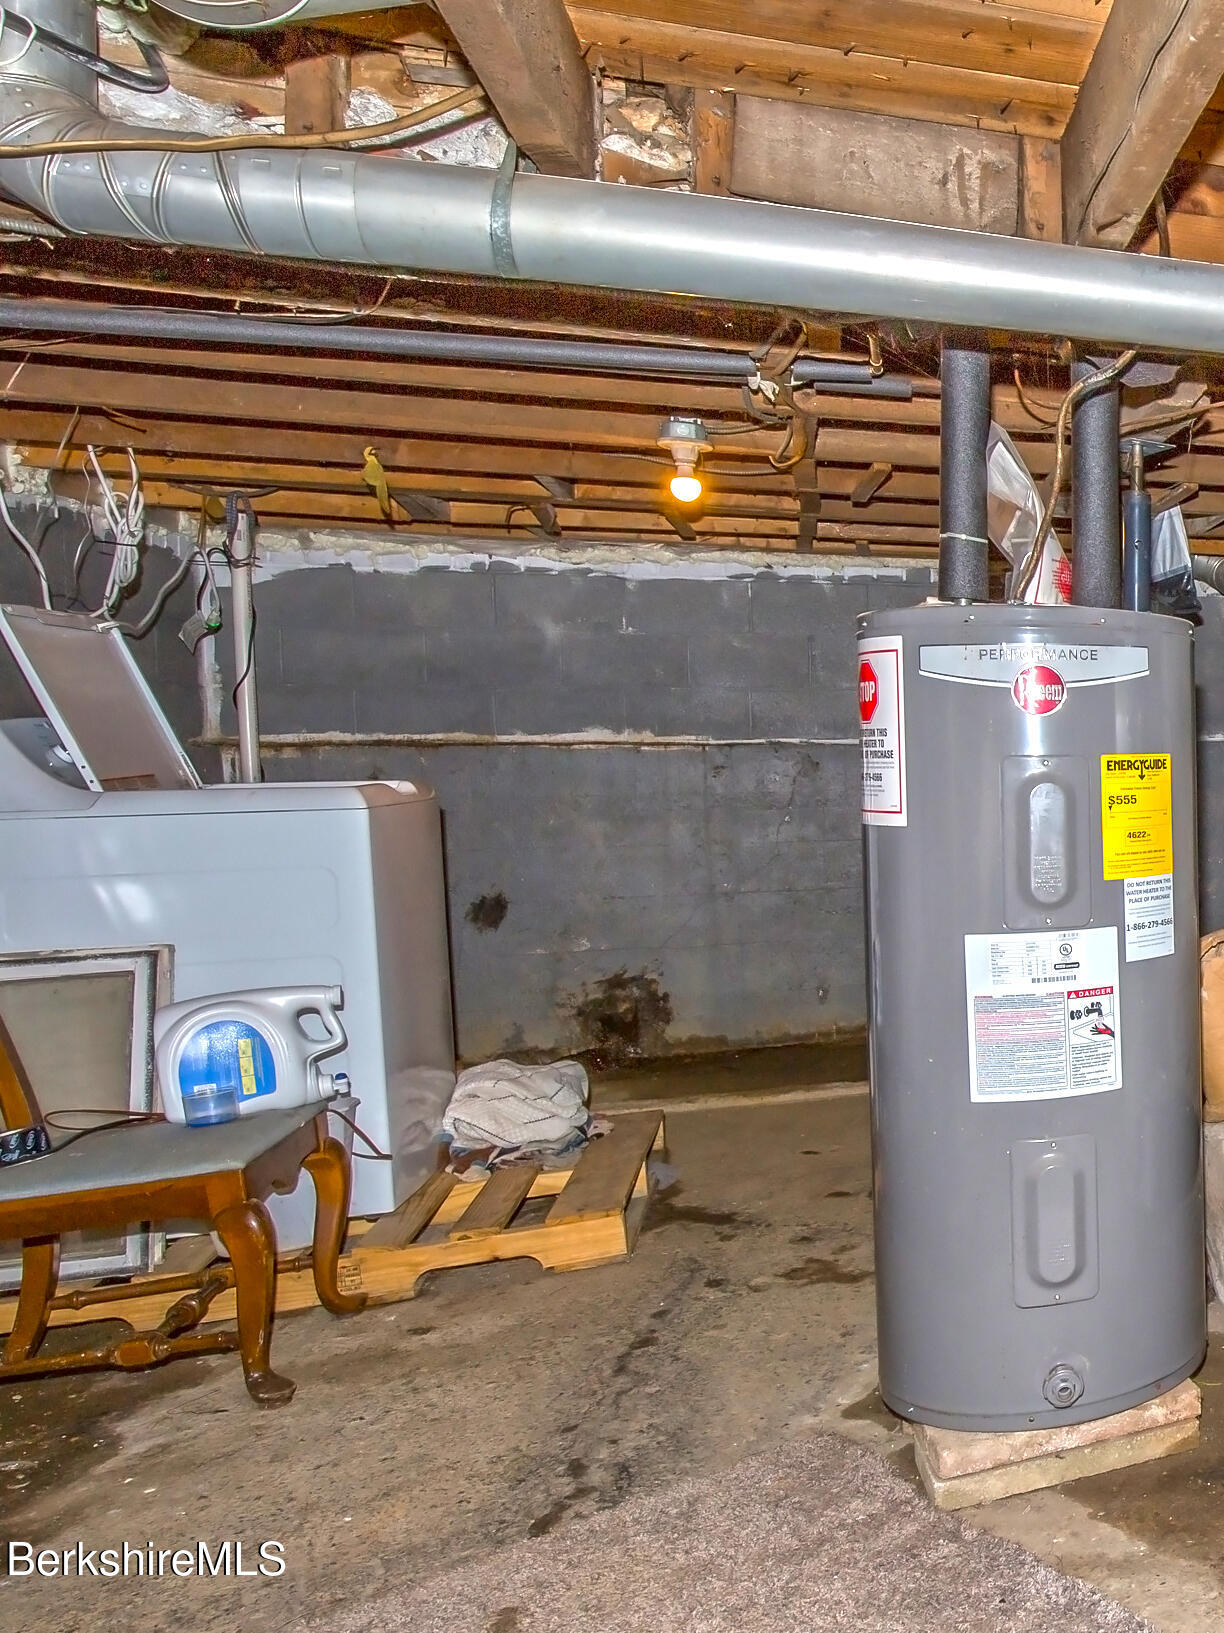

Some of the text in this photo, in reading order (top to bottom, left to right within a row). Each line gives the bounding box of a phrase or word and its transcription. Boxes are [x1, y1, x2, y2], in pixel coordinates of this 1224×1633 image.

[1016, 673, 1063, 708] Reem
[876, 727, 888, 738] THIS
[878, 739, 885, 748] TO
[870, 749, 894, 759] PURCHASE
[1108, 795, 1138, 806] $555
[1126, 831, 1147, 839] 4622
[1078, 987, 1112, 998] DANGER
